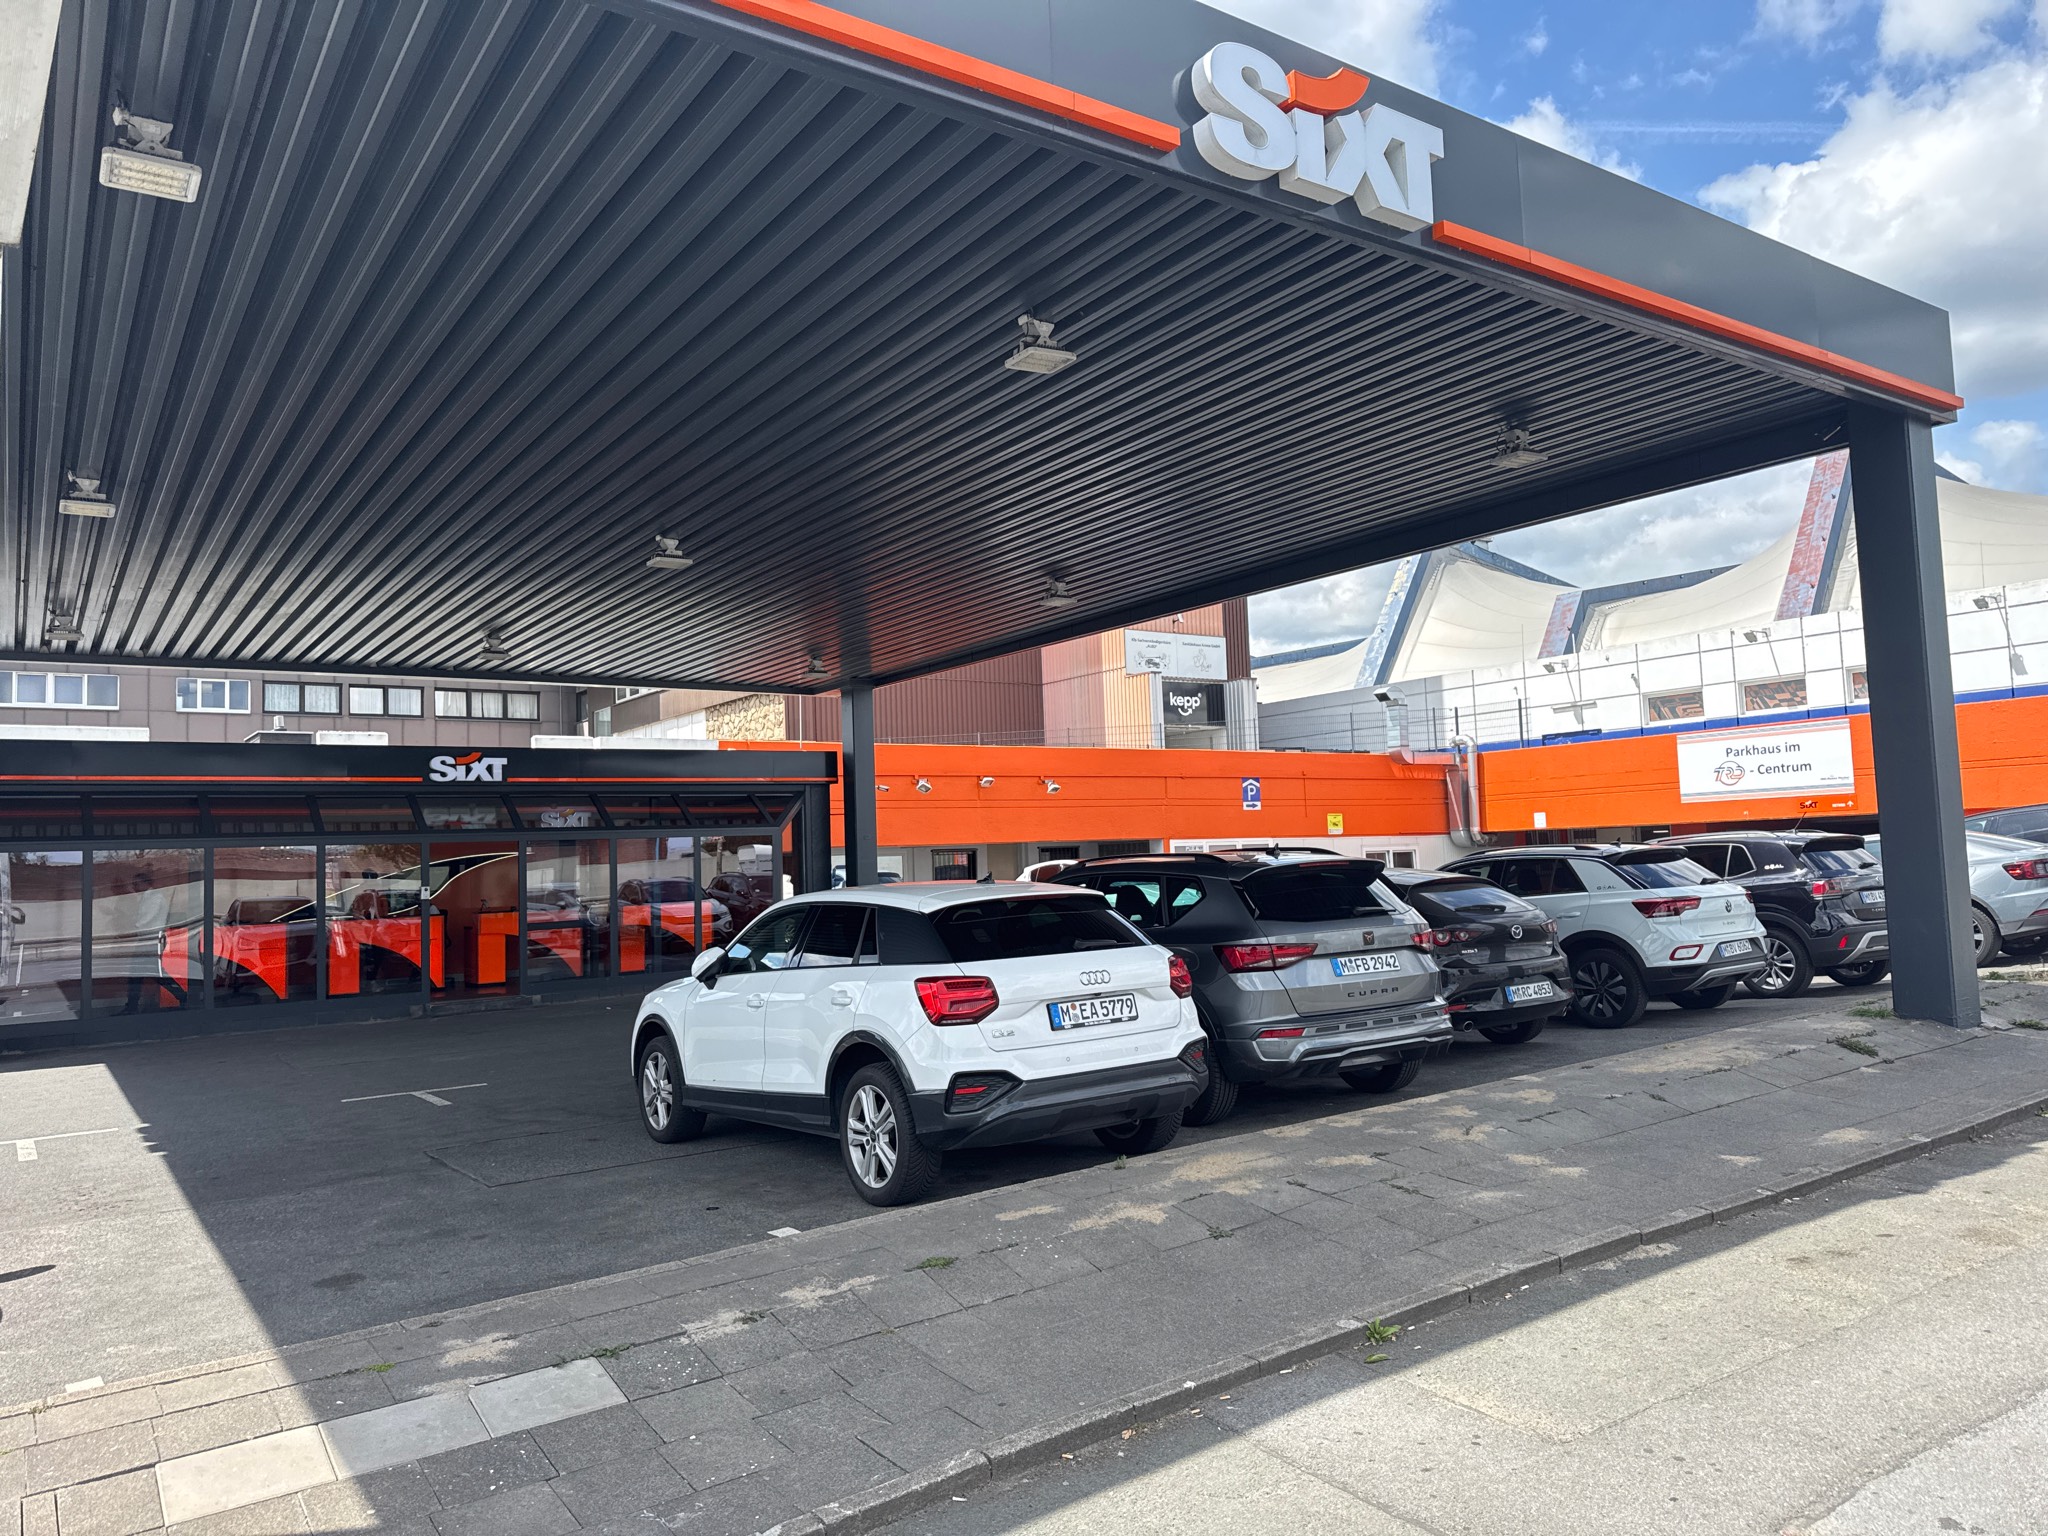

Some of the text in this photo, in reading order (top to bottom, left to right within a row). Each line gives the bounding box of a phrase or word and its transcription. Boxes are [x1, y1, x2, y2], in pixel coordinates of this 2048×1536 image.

[1725, 742, 1801, 758] Parkhaus im
[1757, 762, 1812, 775] Centrum
[1354, 957, 1371, 972] FB
[1370, 954, 1399, 970] 2942
[1347, 986, 1399, 998] CUPRA
[1533, 983, 1552, 996] 4853
[1079, 1001, 1099, 1020] EA
[1100, 997, 1134, 1018] 5779
